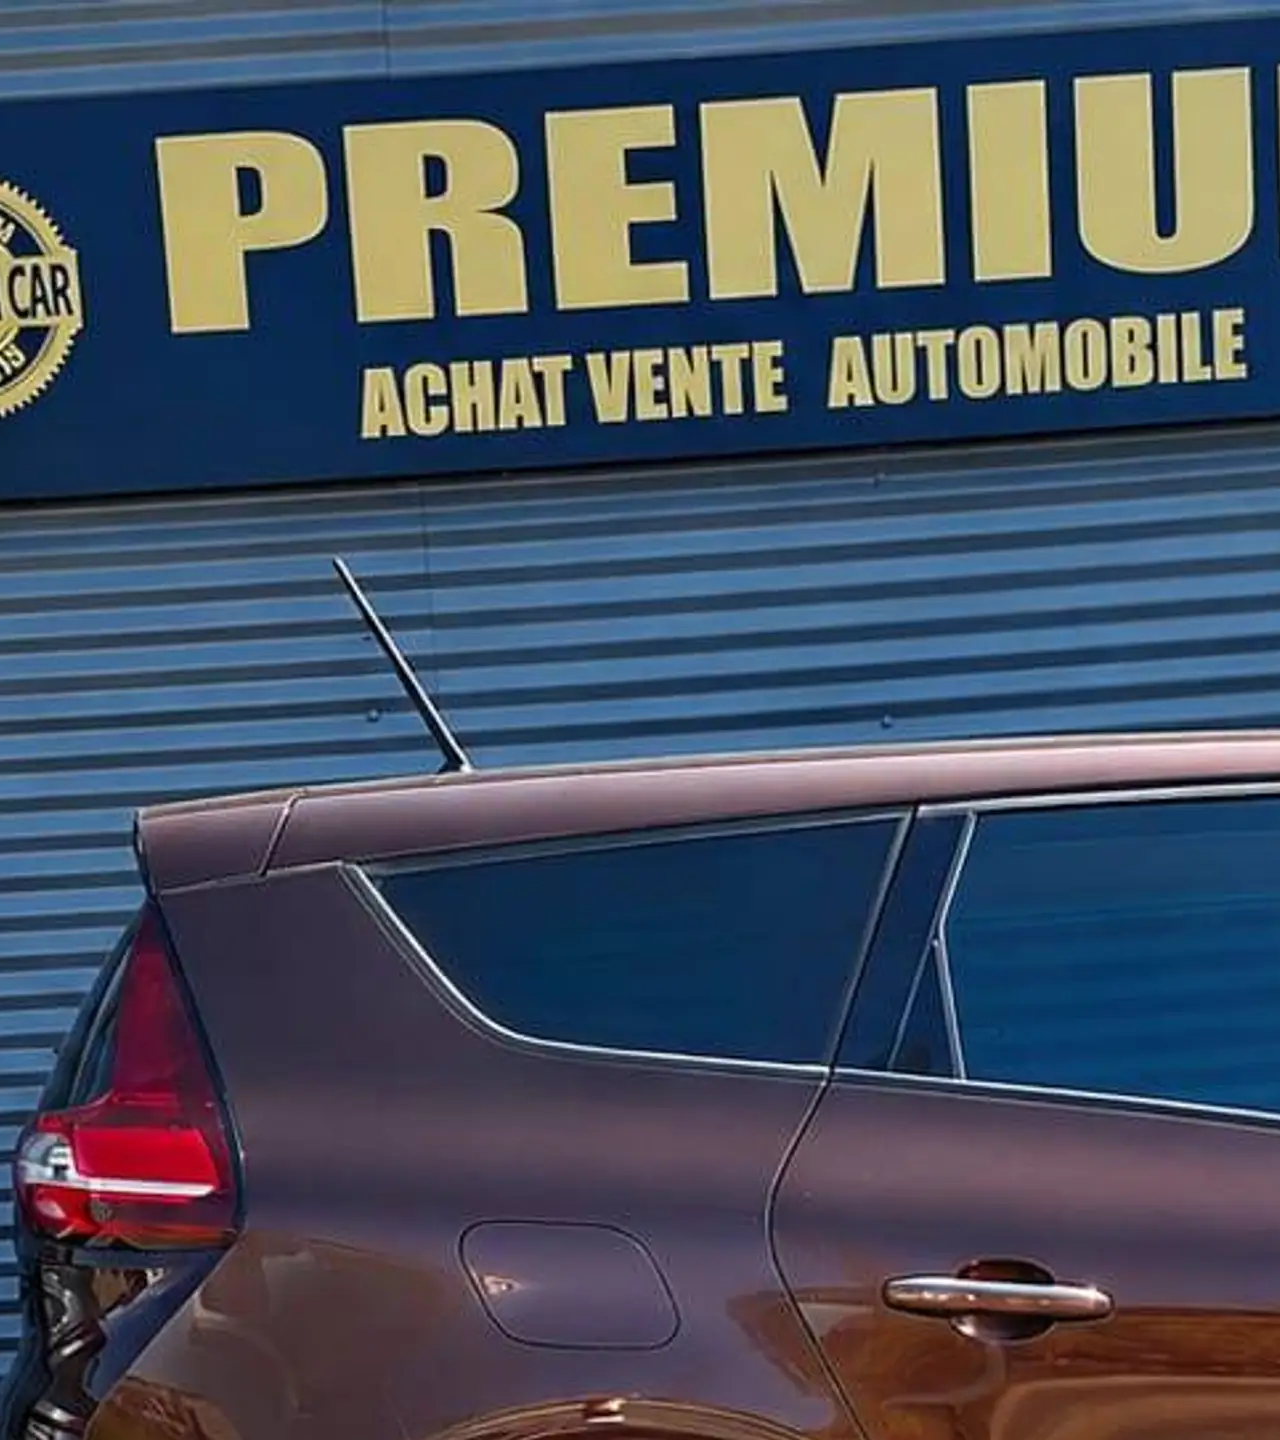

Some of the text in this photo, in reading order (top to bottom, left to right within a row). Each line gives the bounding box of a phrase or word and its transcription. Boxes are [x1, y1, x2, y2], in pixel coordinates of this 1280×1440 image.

[8, 263, 74, 319] CAR
[359, 307, 1249, 439] ACHAT VENTE AUTOMOBILE
